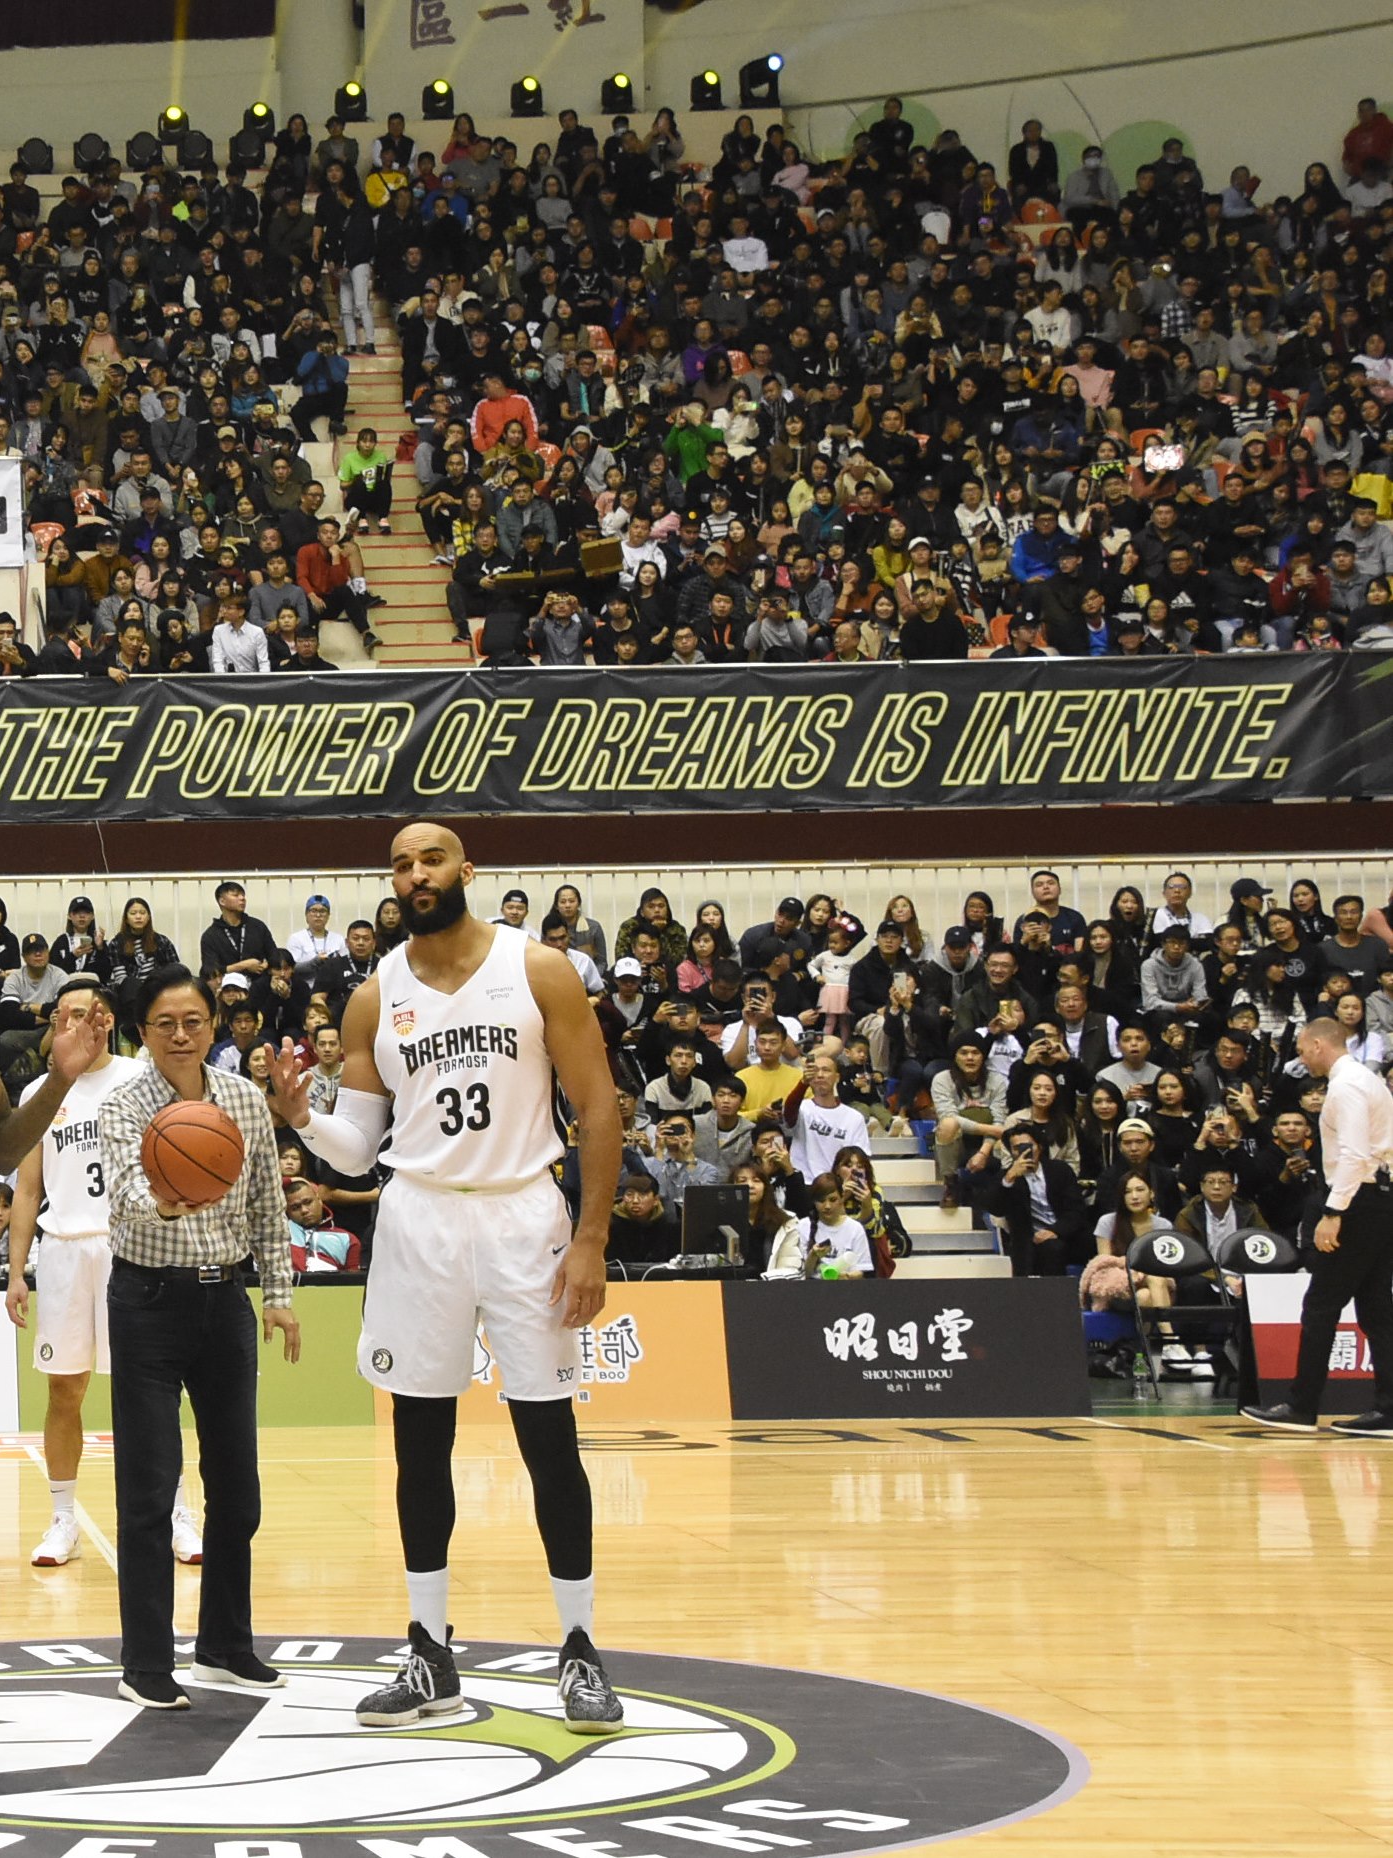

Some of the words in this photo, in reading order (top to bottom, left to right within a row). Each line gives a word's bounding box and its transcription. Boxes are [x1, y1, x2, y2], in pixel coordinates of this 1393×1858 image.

[125, 701, 415, 800] POWER
[413, 697, 534, 795] OF
[519, 694, 853, 793] DREAMS
[845, 691, 949, 788] IS
[941, 683, 1294, 783] INFINITE.
[394, 1011, 414, 1025] ABL
[399, 1025, 518, 1077] DREAMERS
[436, 1055, 488, 1076] FORMOSA
[436, 1082, 491, 1136] 33
[86, 1162, 106, 1197] 3
[600, 1371, 626, 1380] BOO
[862, 1369, 893, 1380] SHOU
[894, 1369, 927, 1380] NICHI
[928, 1368, 953, 1380] DOU
